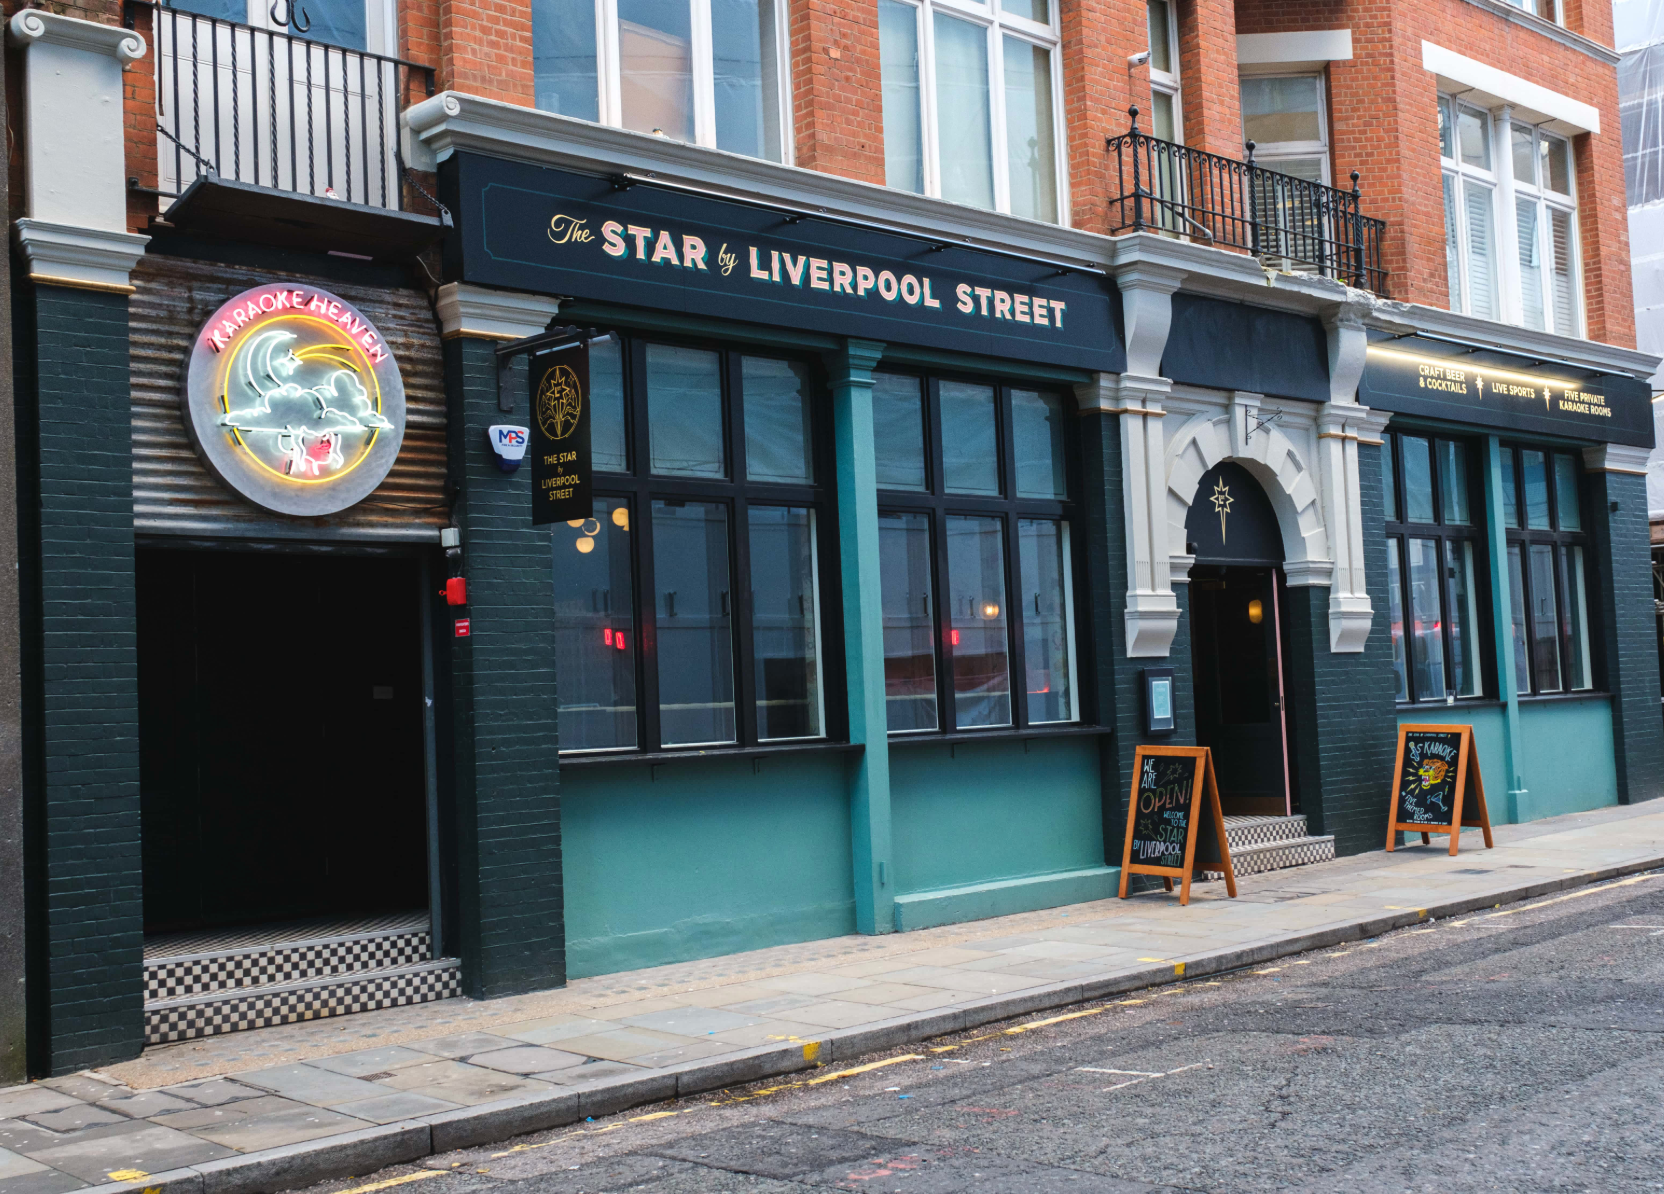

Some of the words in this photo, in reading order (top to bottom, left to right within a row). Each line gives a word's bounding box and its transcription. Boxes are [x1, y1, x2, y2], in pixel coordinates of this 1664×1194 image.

[548, 214, 595, 243] The
[601, 220, 709, 274] STAR
[718, 243, 738, 276] by
[749, 246, 942, 312] LIVERPOOL
[956, 283, 1067, 331] STREET
[207, 290, 304, 352] KARAOKE
[307, 294, 389, 363] HEAVEN
[1419, 365, 1443, 378] CRAFT
[1446, 369, 1466, 383] BEER
[1419, 376, 1425, 388] &
[1427, 378, 1467, 394] COCKTAILS
[1492, 382, 1507, 395] LIVE
[1509, 385, 1535, 399] SPORTS
[1564, 390, 1579, 401] FIVE
[1579, 392, 1605, 406] PRIVATE
[1559, 400, 1590, 414] KARAOKE
[1590, 405, 1612, 418] ROOMS
[499, 430, 525, 444] MPS
[544, 455, 557, 465] THE
[560, 451, 577, 462] STAR
[542, 474, 580, 488] LIVERPOOL
[549, 488, 573, 500] STREET
[1424, 741, 1457, 761] KARAOKE
[1144, 759, 1155, 772] WE
[1141, 773, 1157, 788] ARE
[1141, 779, 1191, 813] OPEN!
[1157, 825, 1184, 843] STAR
[1140, 841, 1181, 859] LIVERPOOL
